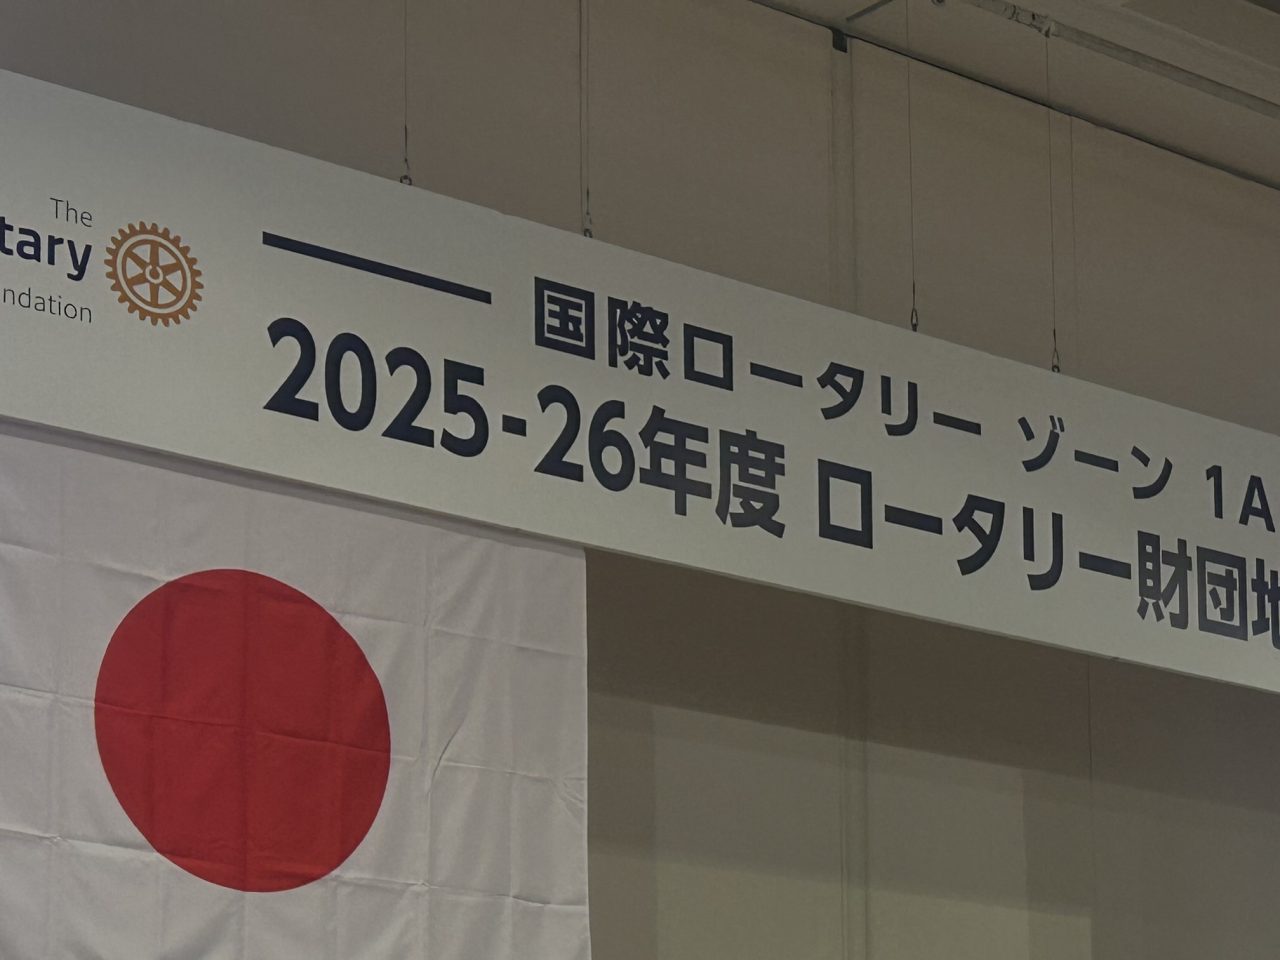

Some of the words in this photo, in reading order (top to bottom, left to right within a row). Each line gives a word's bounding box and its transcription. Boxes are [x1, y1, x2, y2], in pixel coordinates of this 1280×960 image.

[50, 197, 92, 228] The
[263, 317, 785, 539] 2025-26年度
[534, 276, 982, 436] 国際ロータリー
[1017, 415, 1173, 499] ゾーン
